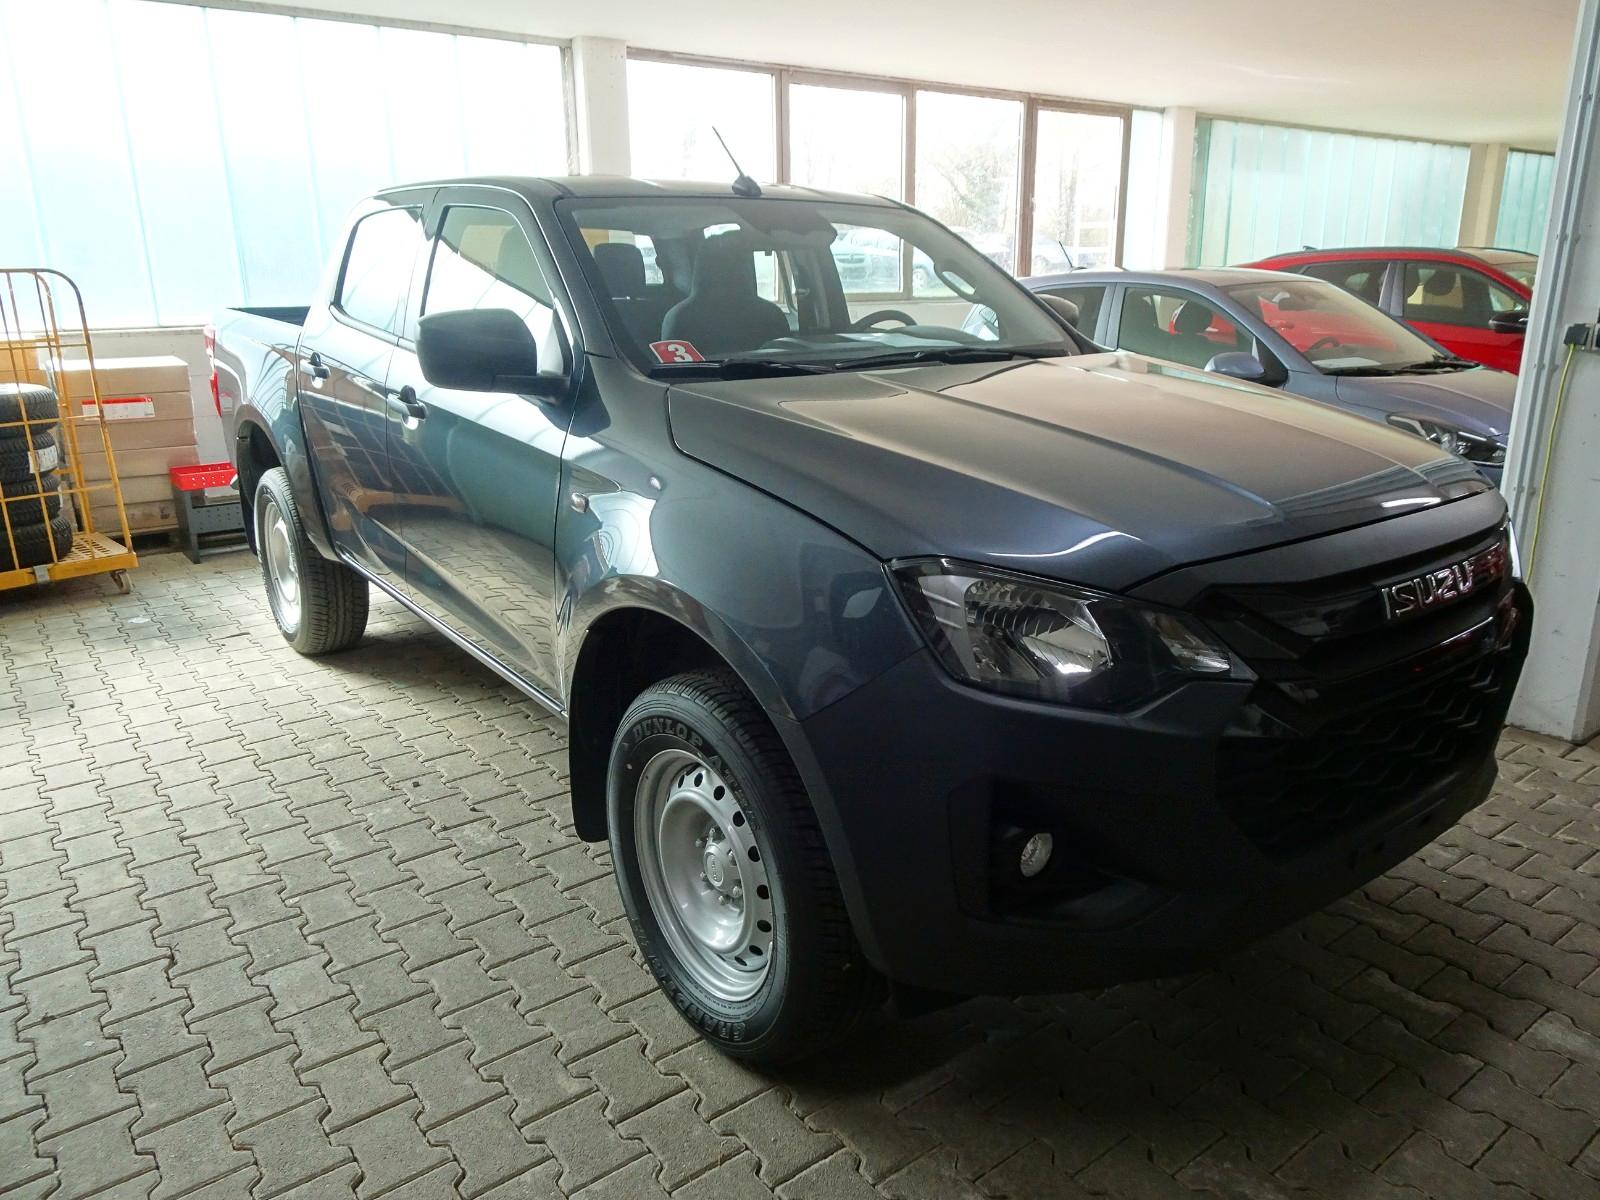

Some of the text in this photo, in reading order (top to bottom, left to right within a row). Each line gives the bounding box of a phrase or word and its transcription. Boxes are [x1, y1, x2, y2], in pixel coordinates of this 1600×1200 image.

[667, 344, 693, 362] 3
[1381, 559, 1475, 619] ISUZU
[632, 717, 703, 747] DUNLOP
